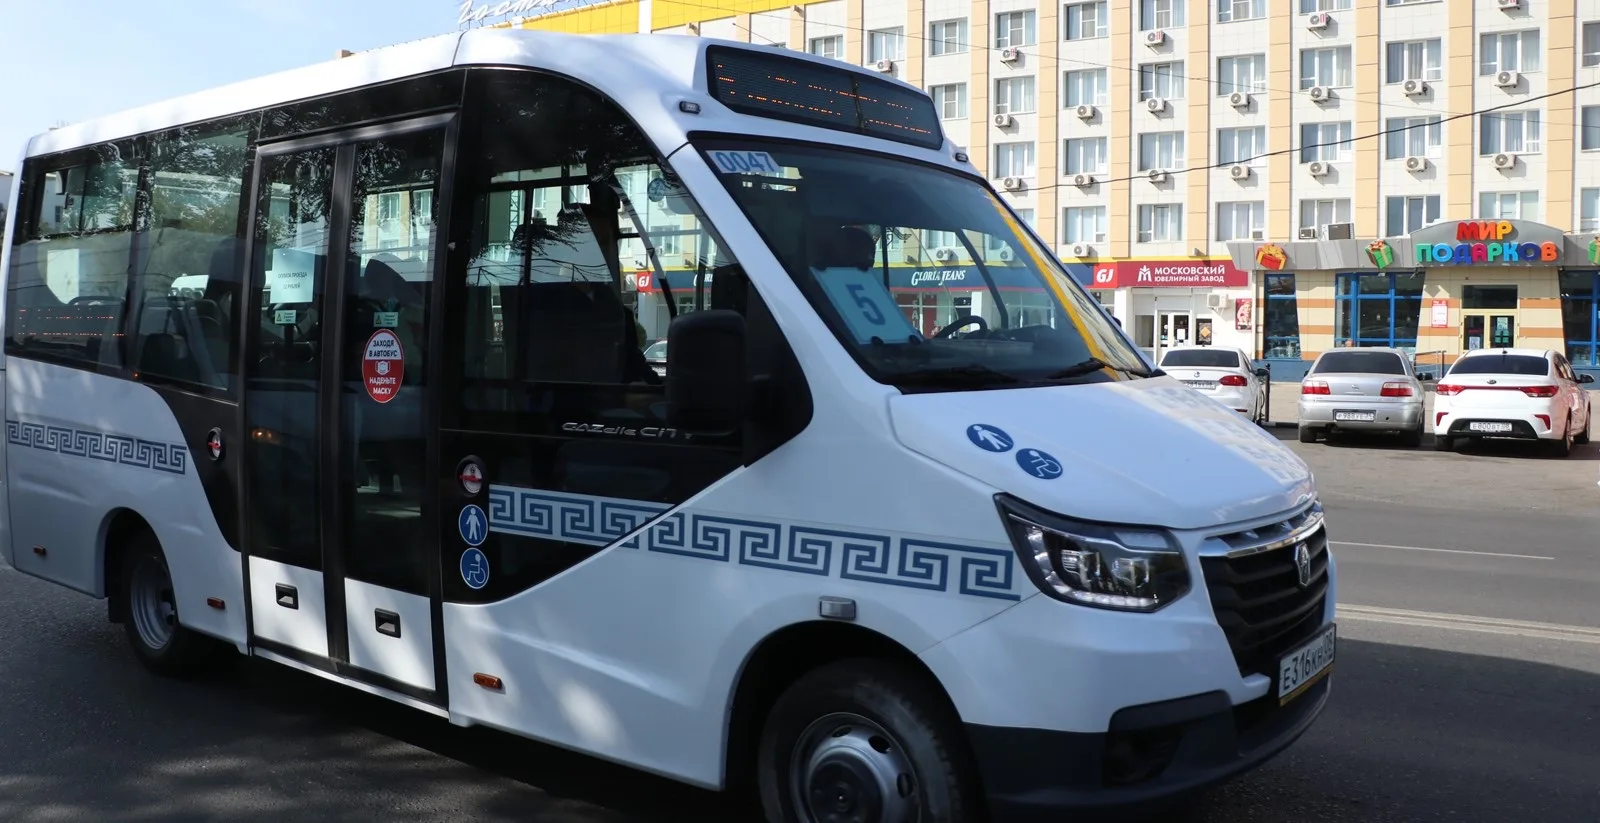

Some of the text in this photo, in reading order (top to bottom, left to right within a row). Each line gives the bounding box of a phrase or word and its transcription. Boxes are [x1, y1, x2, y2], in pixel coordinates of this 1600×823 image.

[715, 151, 775, 172] 0047
[1456, 220, 1514, 241] МИР
[1416, 241, 1558, 265] ПОДАРКОВ
[1096, 268, 1114, 283] GJ
[1154, 264, 1225, 275] МОСКОВСКИЙ
[638, 276, 650, 287] GJ
[911, 269, 966, 286] GLORIA JEANS
[1154, 275, 1200, 283] ЮВЕЛИРНЫЙ
[845, 284, 886, 326] 5
[372, 339, 395, 347] ЗАХОДЯ
[369, 350, 398, 358] В АВТОБУС
[369, 376, 396, 385] НАДЕНЬТЕ
[372, 387, 392, 395] МАСКУ
[562, 421, 637, 436] GAZelle
